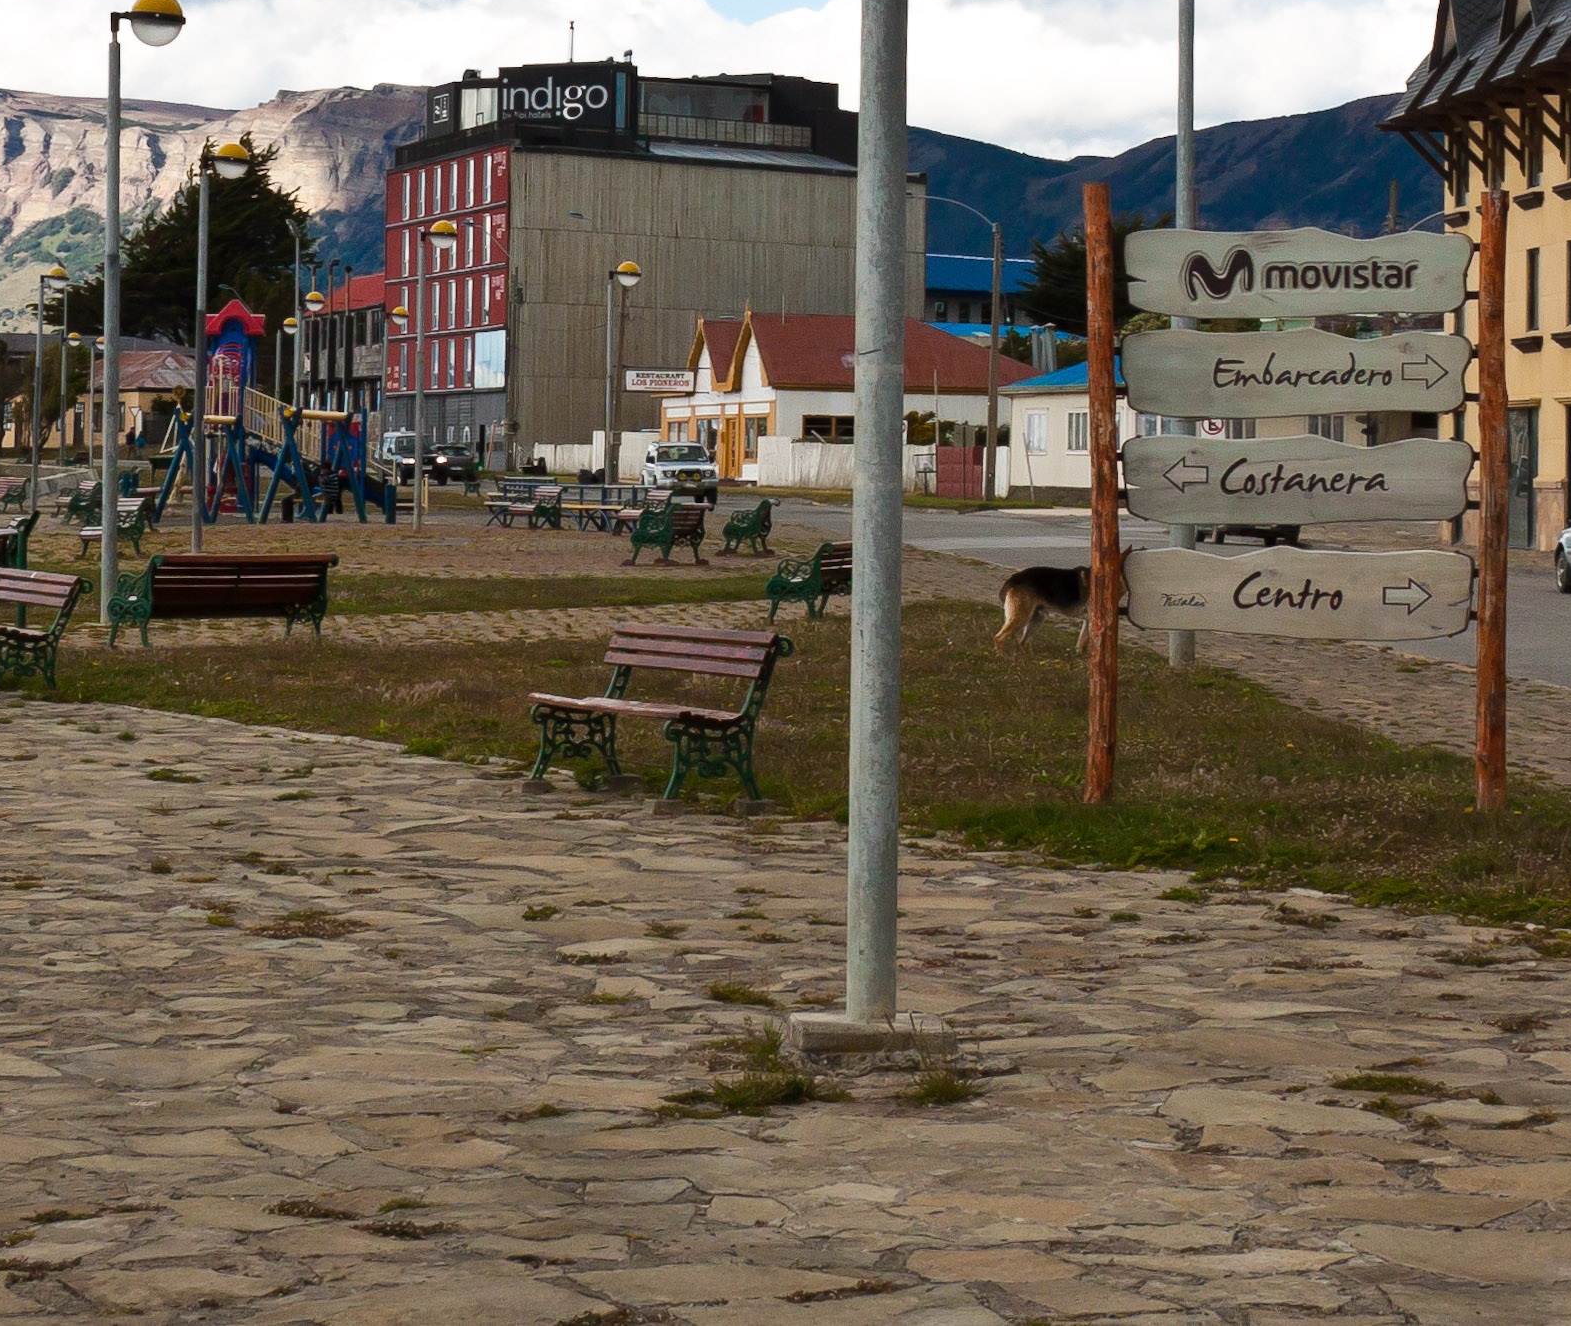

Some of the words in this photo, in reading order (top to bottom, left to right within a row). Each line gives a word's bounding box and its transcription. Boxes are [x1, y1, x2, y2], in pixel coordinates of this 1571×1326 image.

[502, 76, 608, 120] indigo
[1264, 260, 1418, 290] movistar
[649, 379, 690, 387] PIONEROS
[1213, 351, 1393, 389] Embarcadero
[1220, 457, 1390, 496] Costanera
[1233, 571, 1343, 610] Centro
